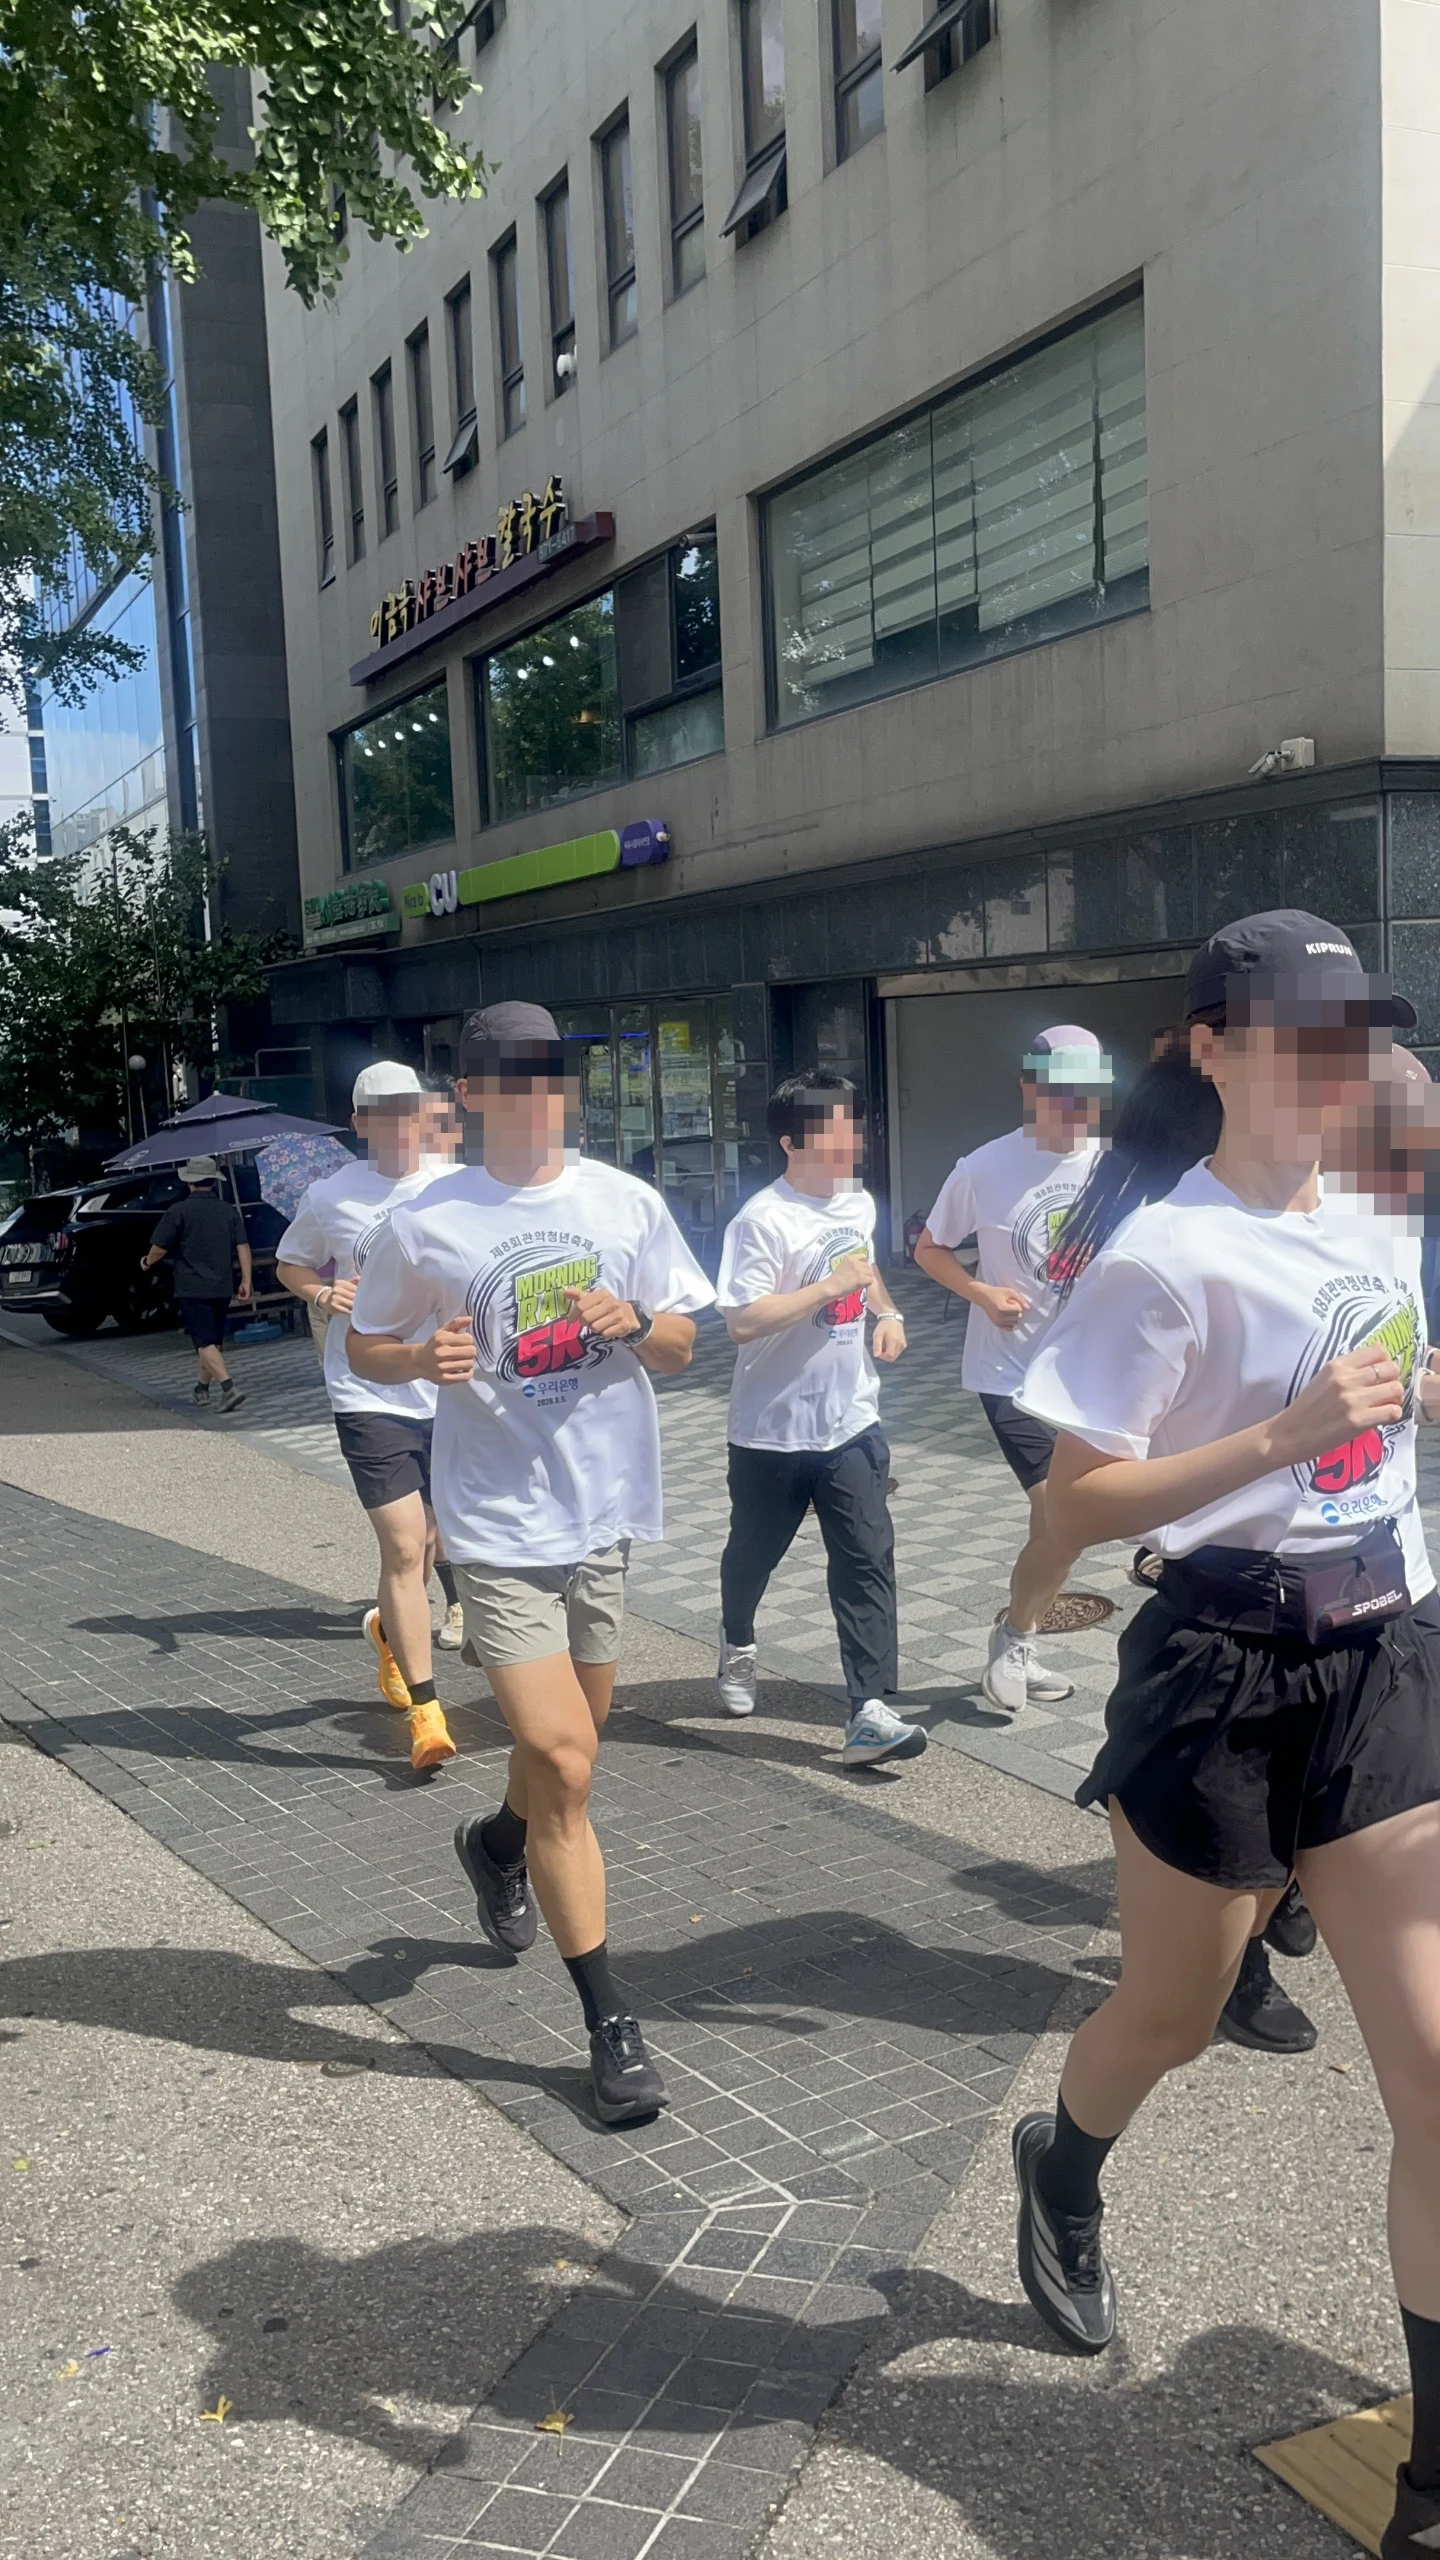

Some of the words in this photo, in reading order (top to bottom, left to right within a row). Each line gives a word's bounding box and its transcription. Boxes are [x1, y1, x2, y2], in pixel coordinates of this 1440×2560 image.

[431, 870, 458, 916] CU
[1305, 942, 1353, 956] KIPRUN
[516, 1255, 597, 1301] MORNING
[517, 1317, 588, 1378] 5K
[537, 1377, 579, 1395] 우리은행
[1351, 1589, 1403, 1617] SPOBEL
